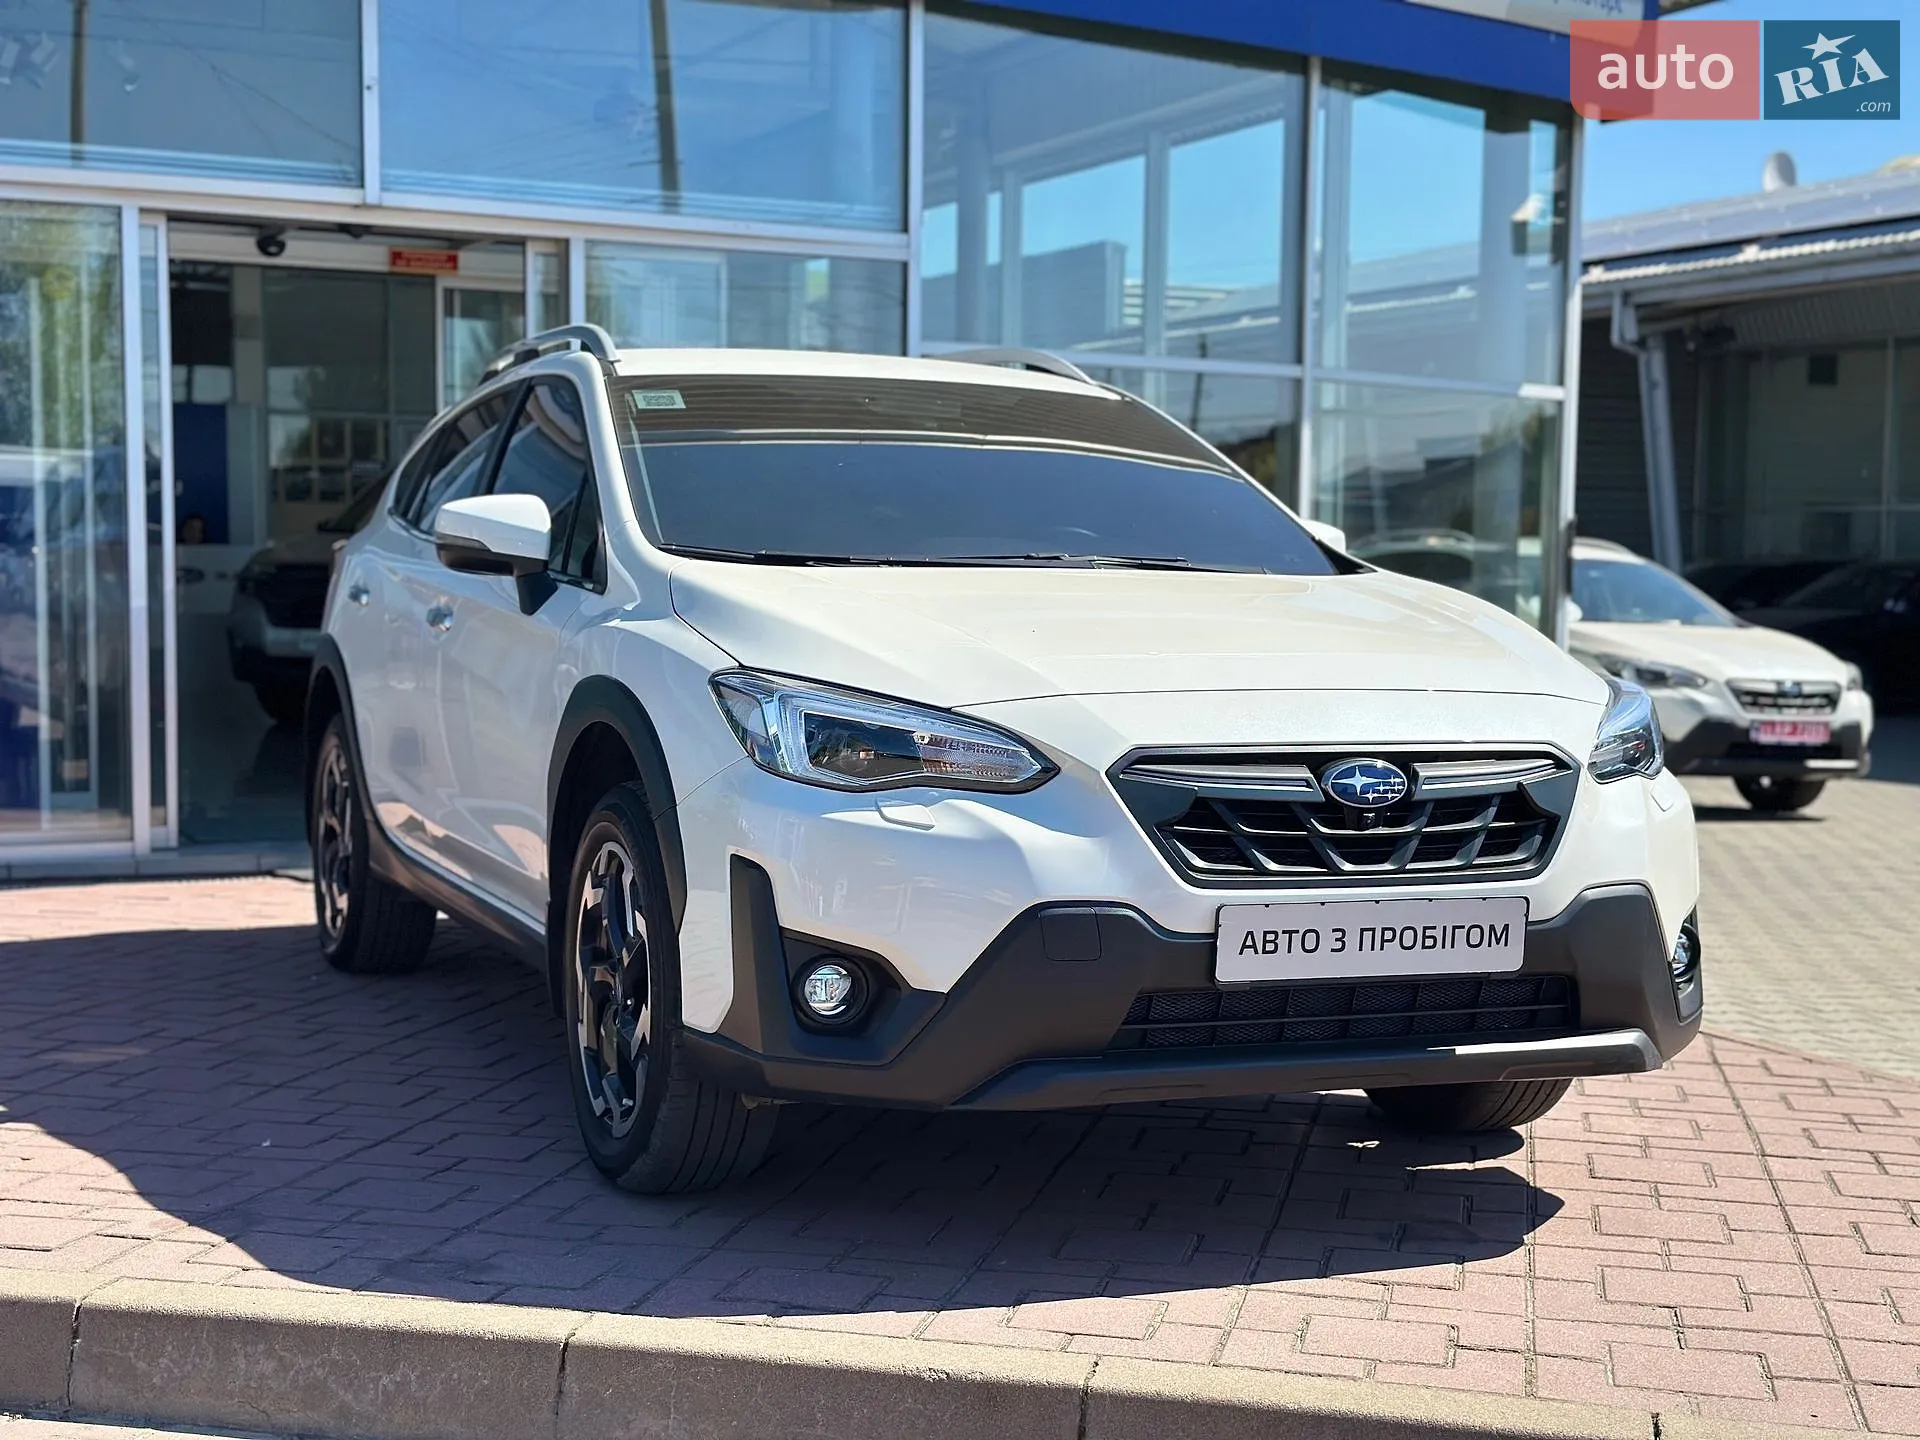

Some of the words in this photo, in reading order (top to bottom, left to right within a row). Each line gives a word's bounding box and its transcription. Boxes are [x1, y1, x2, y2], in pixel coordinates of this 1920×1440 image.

[1239, 928, 1321, 956] АВТО
[1330, 927, 1346, 953] З
[1358, 923, 1510, 952] ПРОБІГОМ
